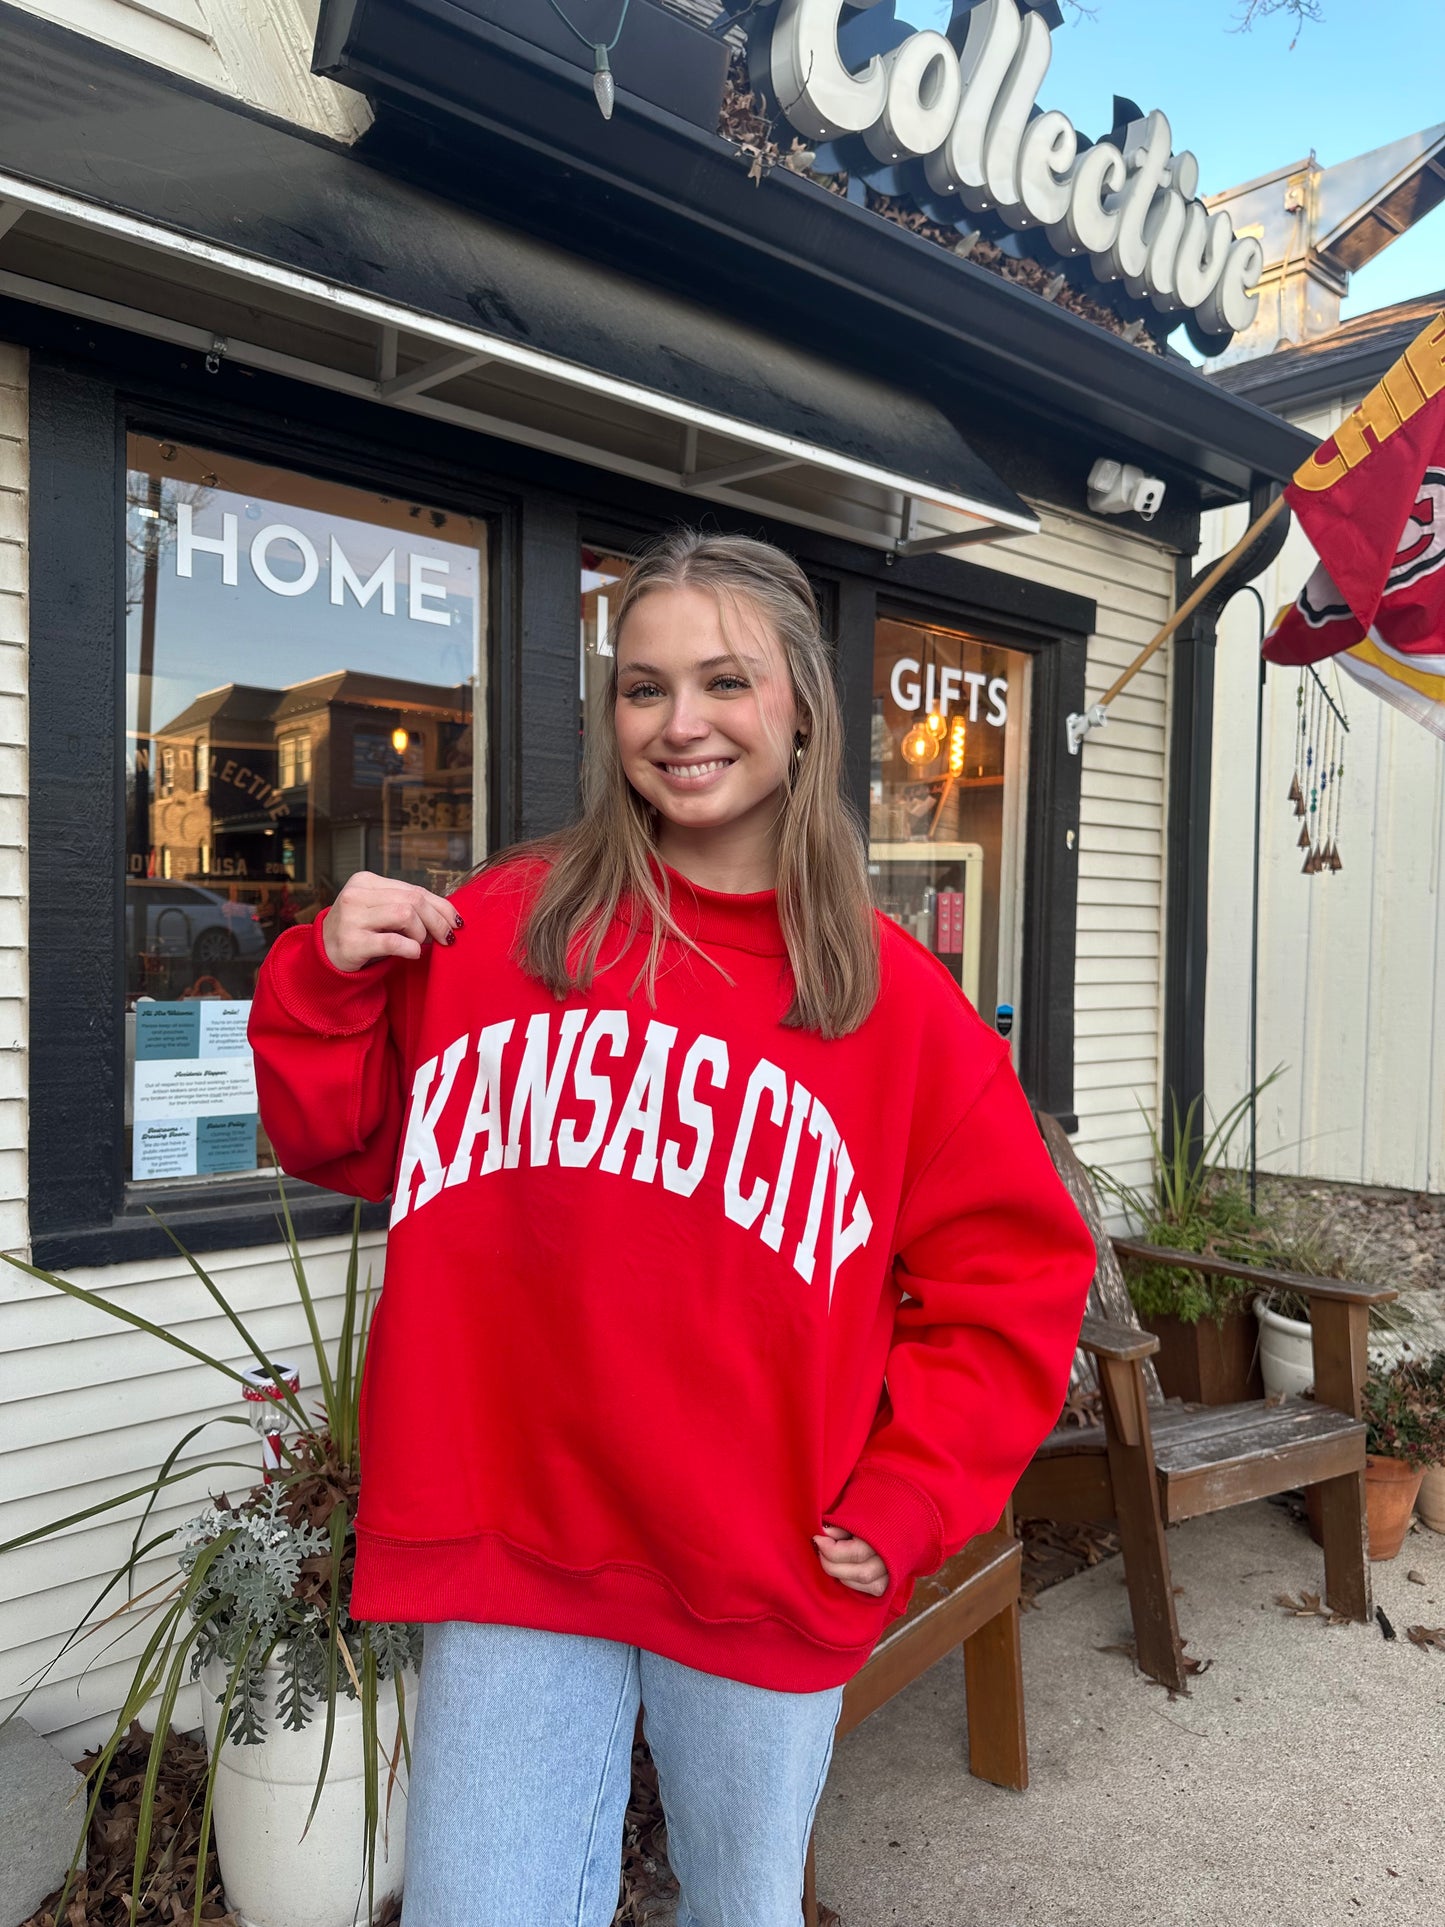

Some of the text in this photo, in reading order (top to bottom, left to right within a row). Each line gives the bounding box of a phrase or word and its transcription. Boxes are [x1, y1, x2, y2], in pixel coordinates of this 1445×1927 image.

[772, 0, 1263, 332] Collective
[176, 502, 451, 627] HOME
[890, 656, 1009, 728] GIFTS
[210, 857, 249, 876] USA
[389, 1009, 874, 1316] KANSAS CITY
